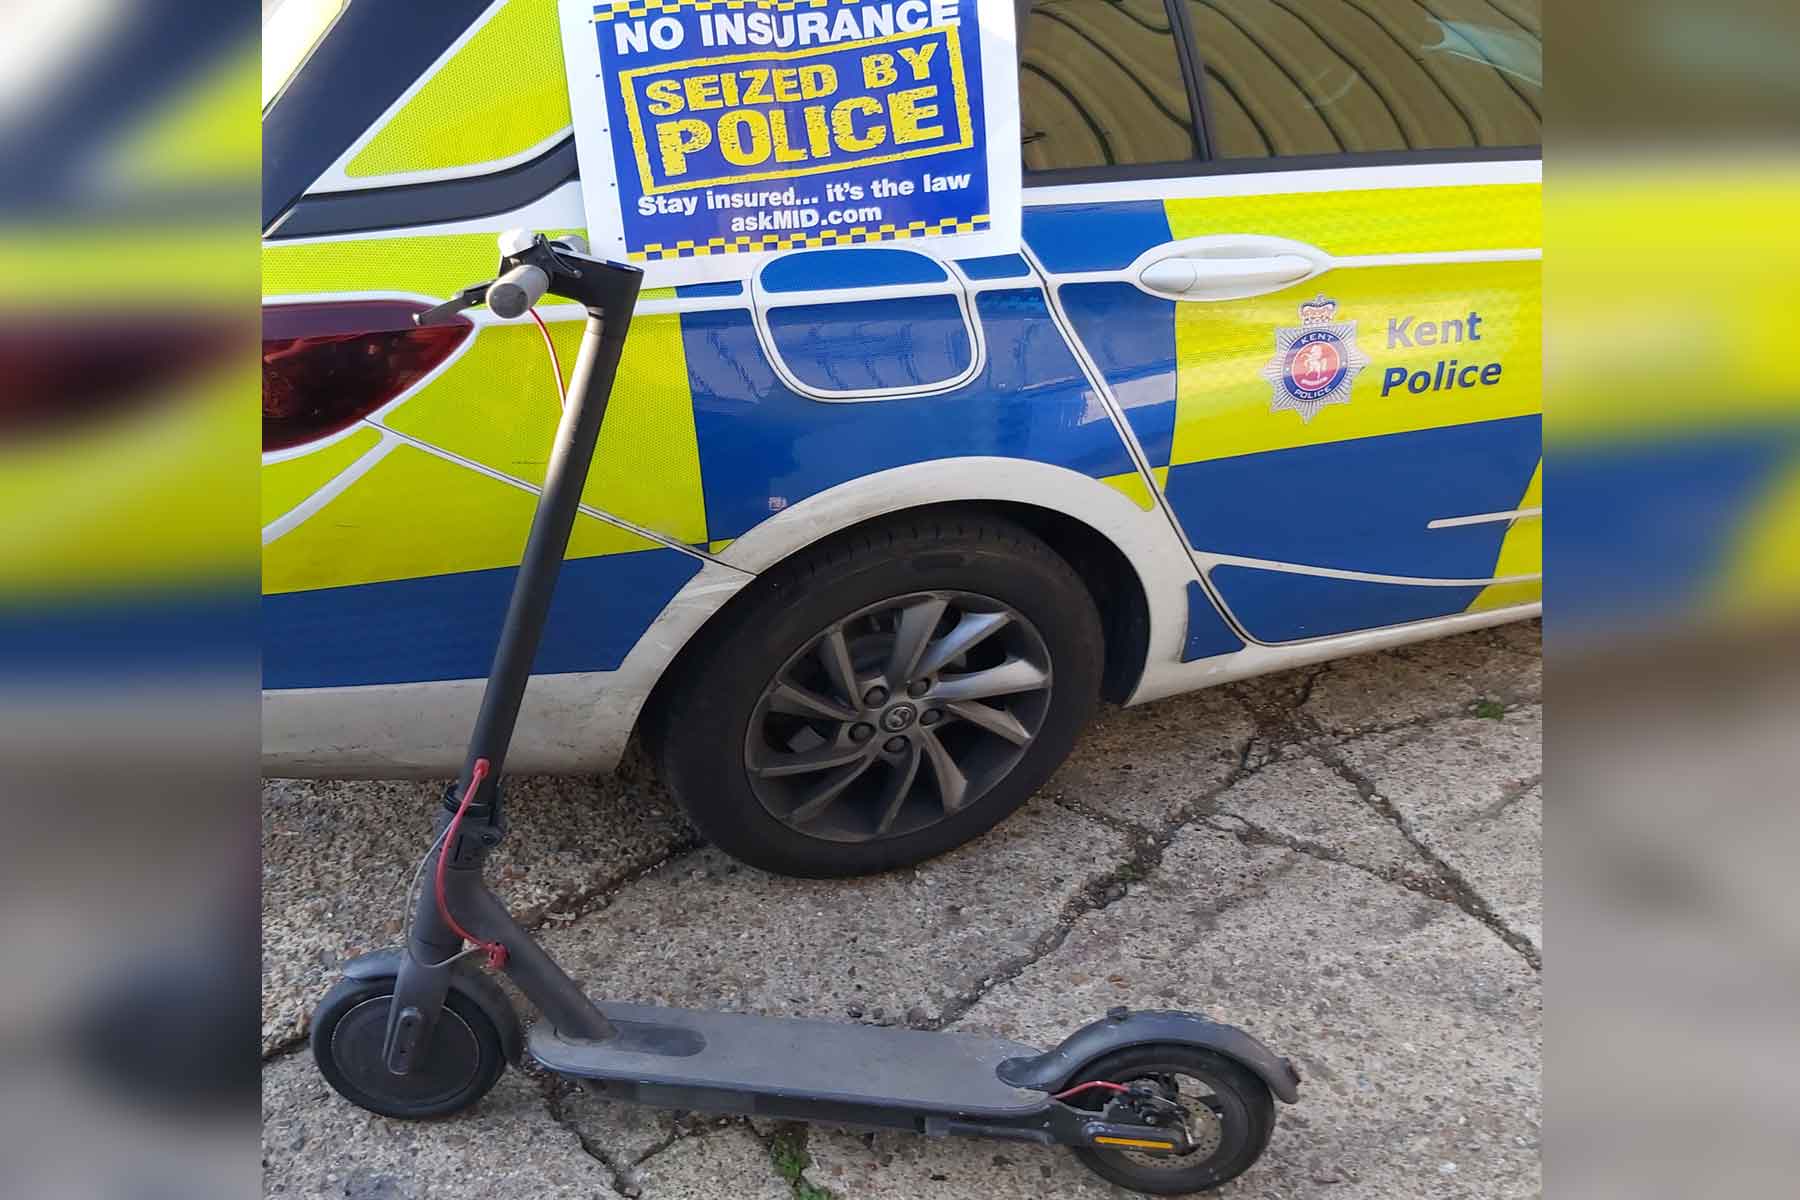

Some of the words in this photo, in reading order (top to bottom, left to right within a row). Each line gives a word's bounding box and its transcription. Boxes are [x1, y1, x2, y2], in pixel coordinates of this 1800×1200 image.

[614, 17, 685, 56] NO
[700, 0, 961, 48] INSURANCE
[646, 64, 838, 116] SEIZED
[862, 42, 938, 89] BY
[655, 85, 944, 177] POLICE
[638, 195, 698, 217] Stay
[706, 186, 819, 210] insured...
[826, 181, 864, 203] it's
[870, 178, 914, 199] the
[923, 173, 972, 193] law
[731, 206, 882, 232] askMID.com
[1301, 333, 1334, 345] KENT
[1387, 311, 1482, 349] Kent
[1293, 385, 1332, 399] POLICE
[1380, 359, 1502, 398] Police
